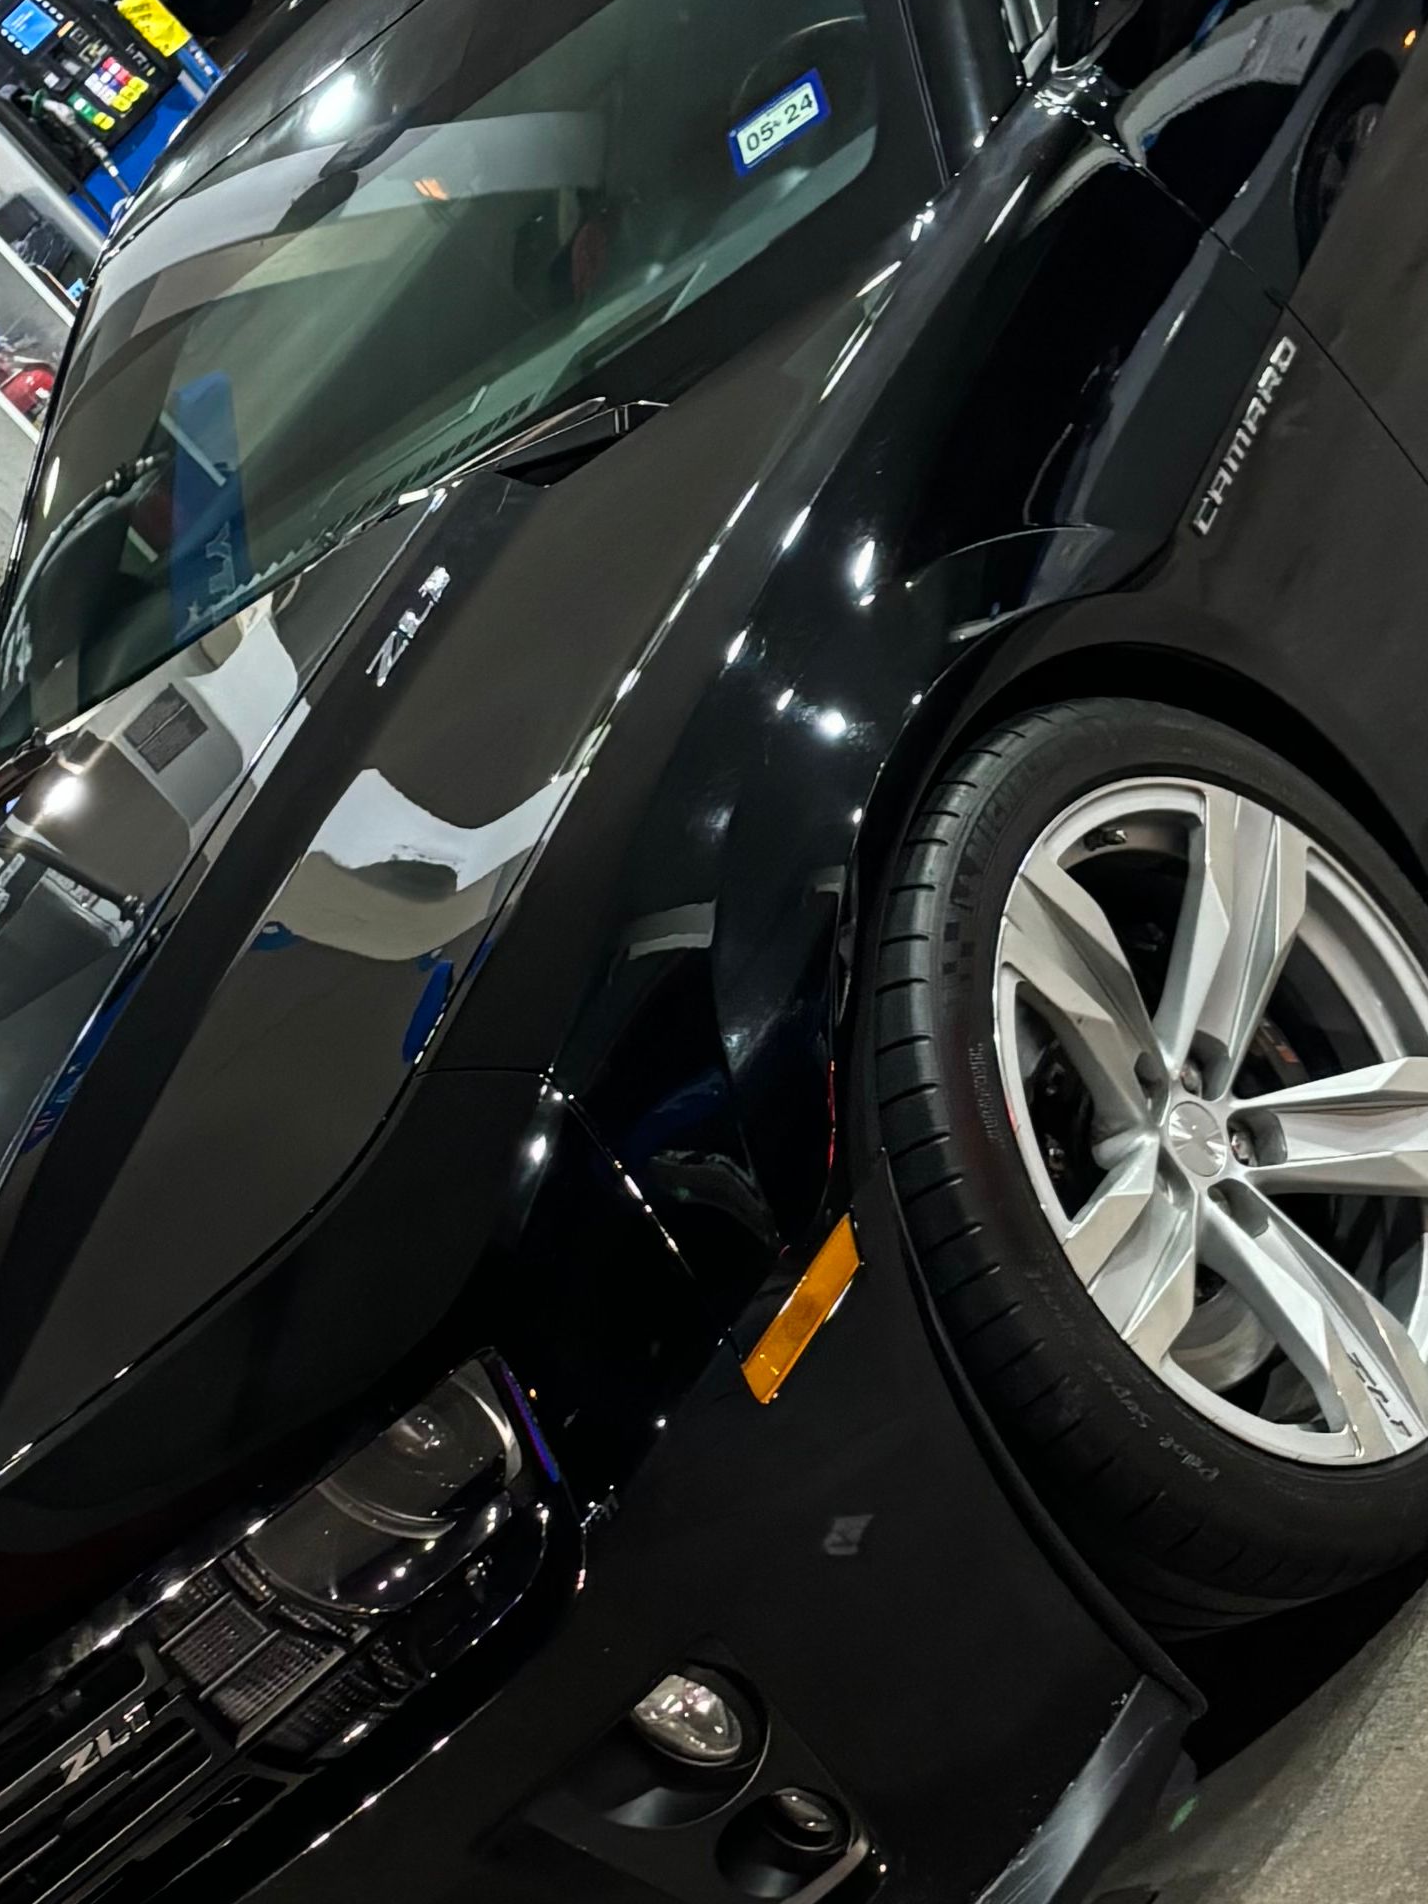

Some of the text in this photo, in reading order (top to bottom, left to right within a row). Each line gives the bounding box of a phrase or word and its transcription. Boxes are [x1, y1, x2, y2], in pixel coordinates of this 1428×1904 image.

[1192, 335, 1297, 535] CAMARO
[365, 565, 451, 687] ZL1
[59, 1701, 151, 1786] ZL1
